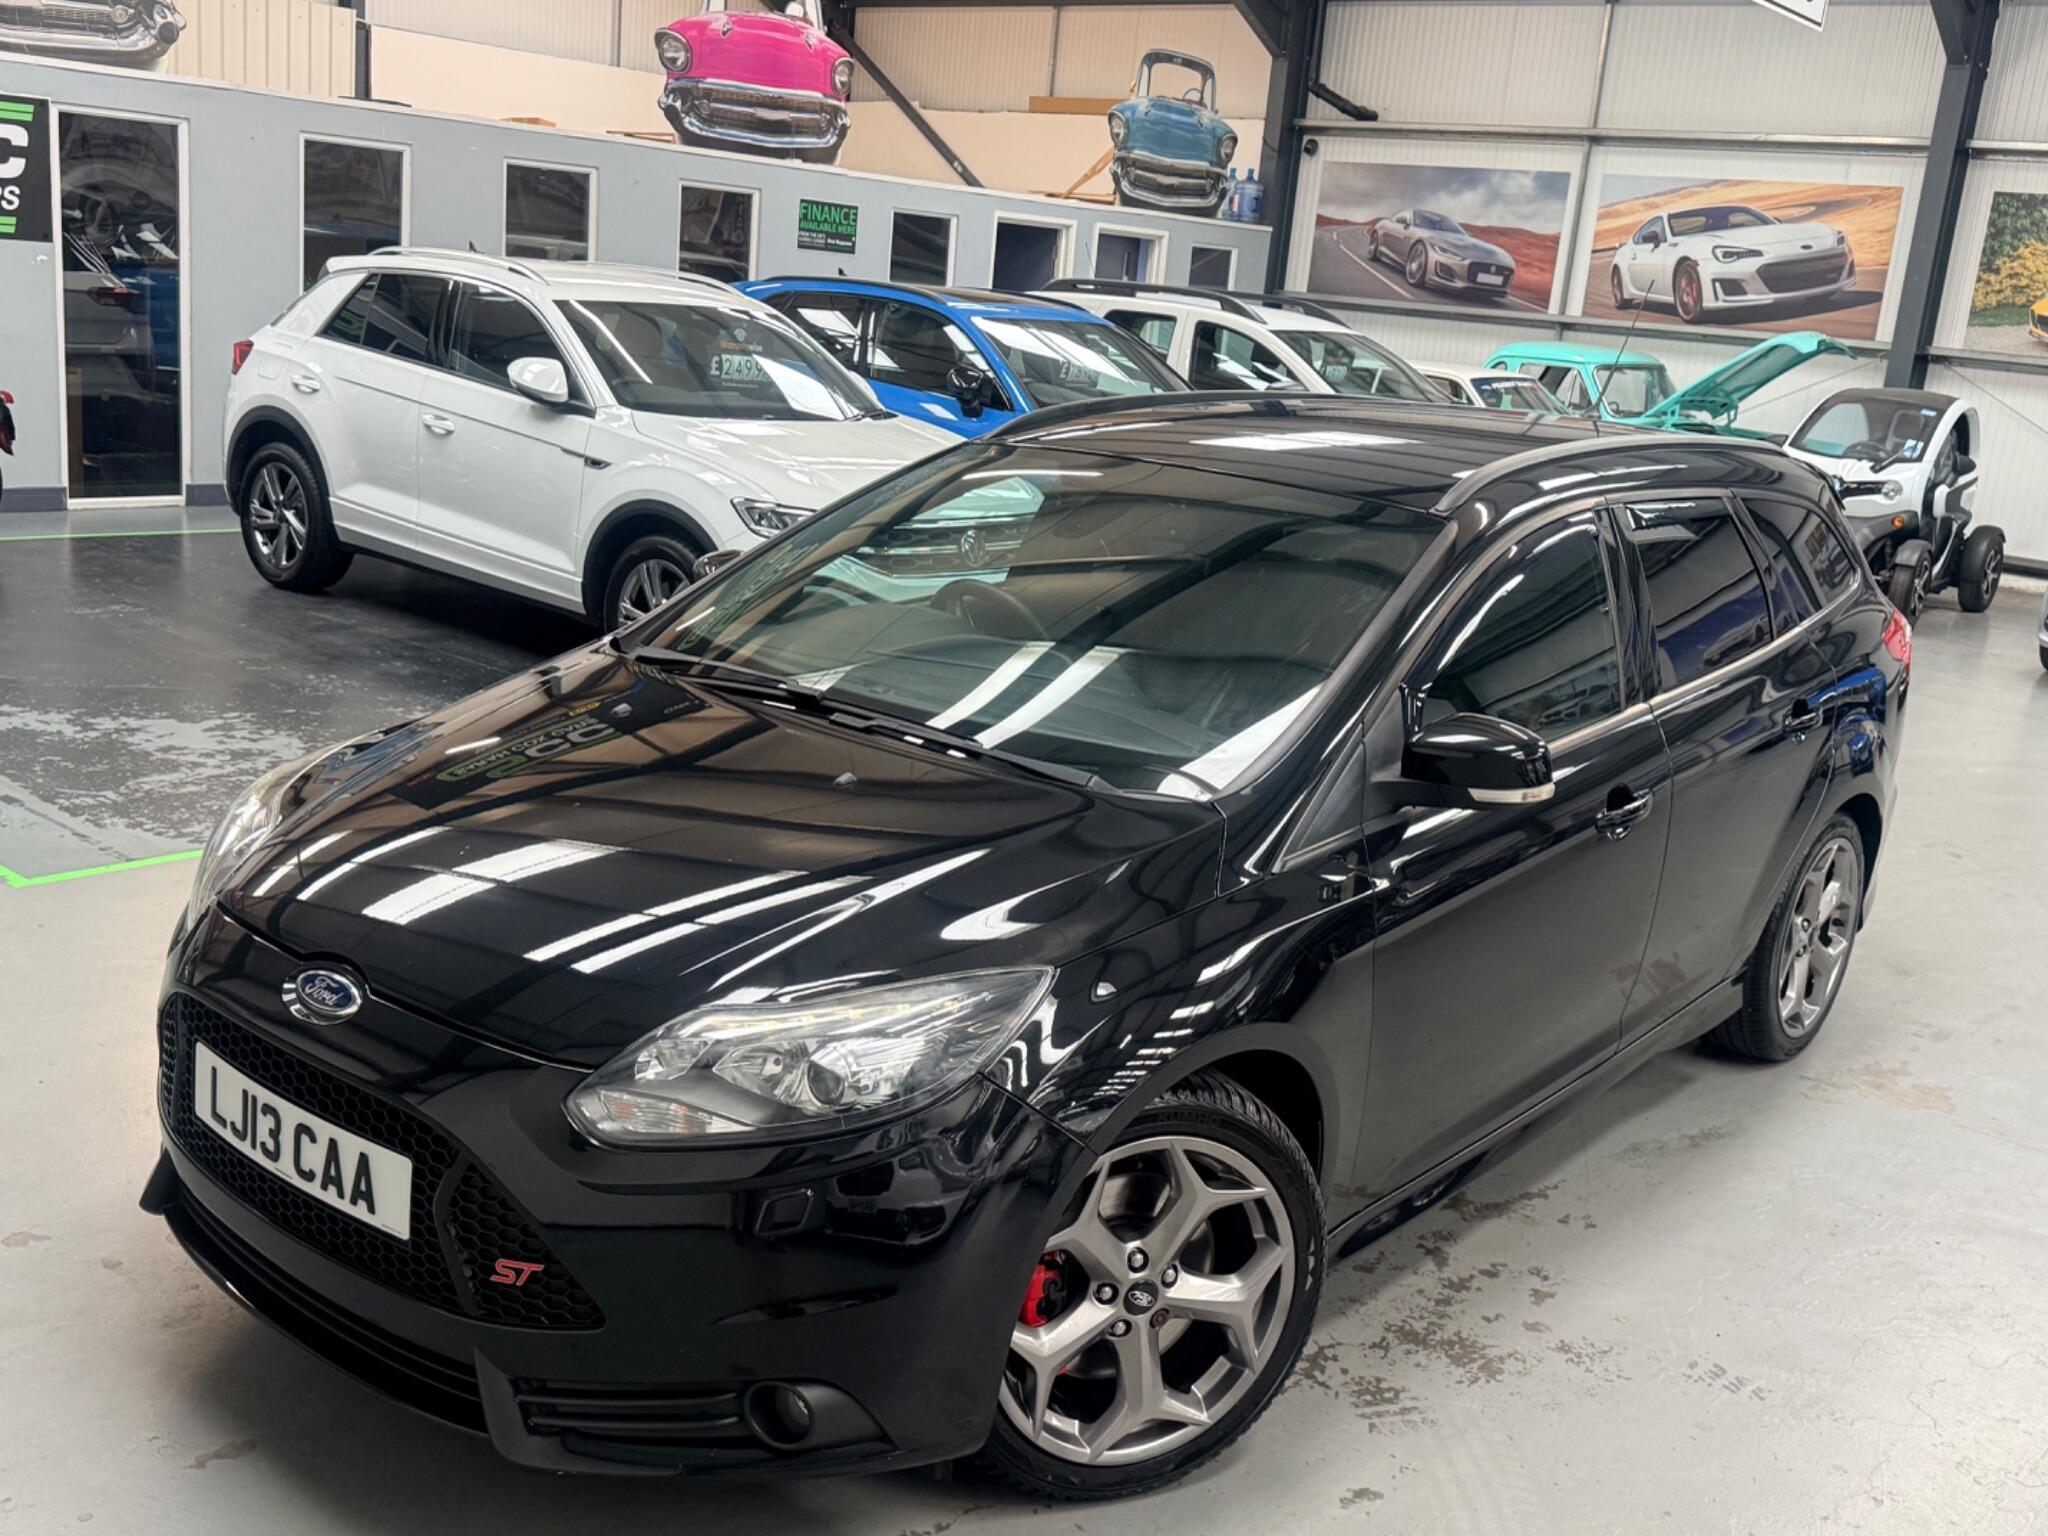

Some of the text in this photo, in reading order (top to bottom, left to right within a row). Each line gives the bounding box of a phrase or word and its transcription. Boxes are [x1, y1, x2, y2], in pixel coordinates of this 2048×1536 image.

[800, 202, 857, 226] FINANCE
[800, 220, 856, 236] AVAILABLE HERE
[305, 976, 344, 1005] Ford
[211, 1066, 376, 1215] LJ13 CAA
[490, 1259, 544, 1286] ST
